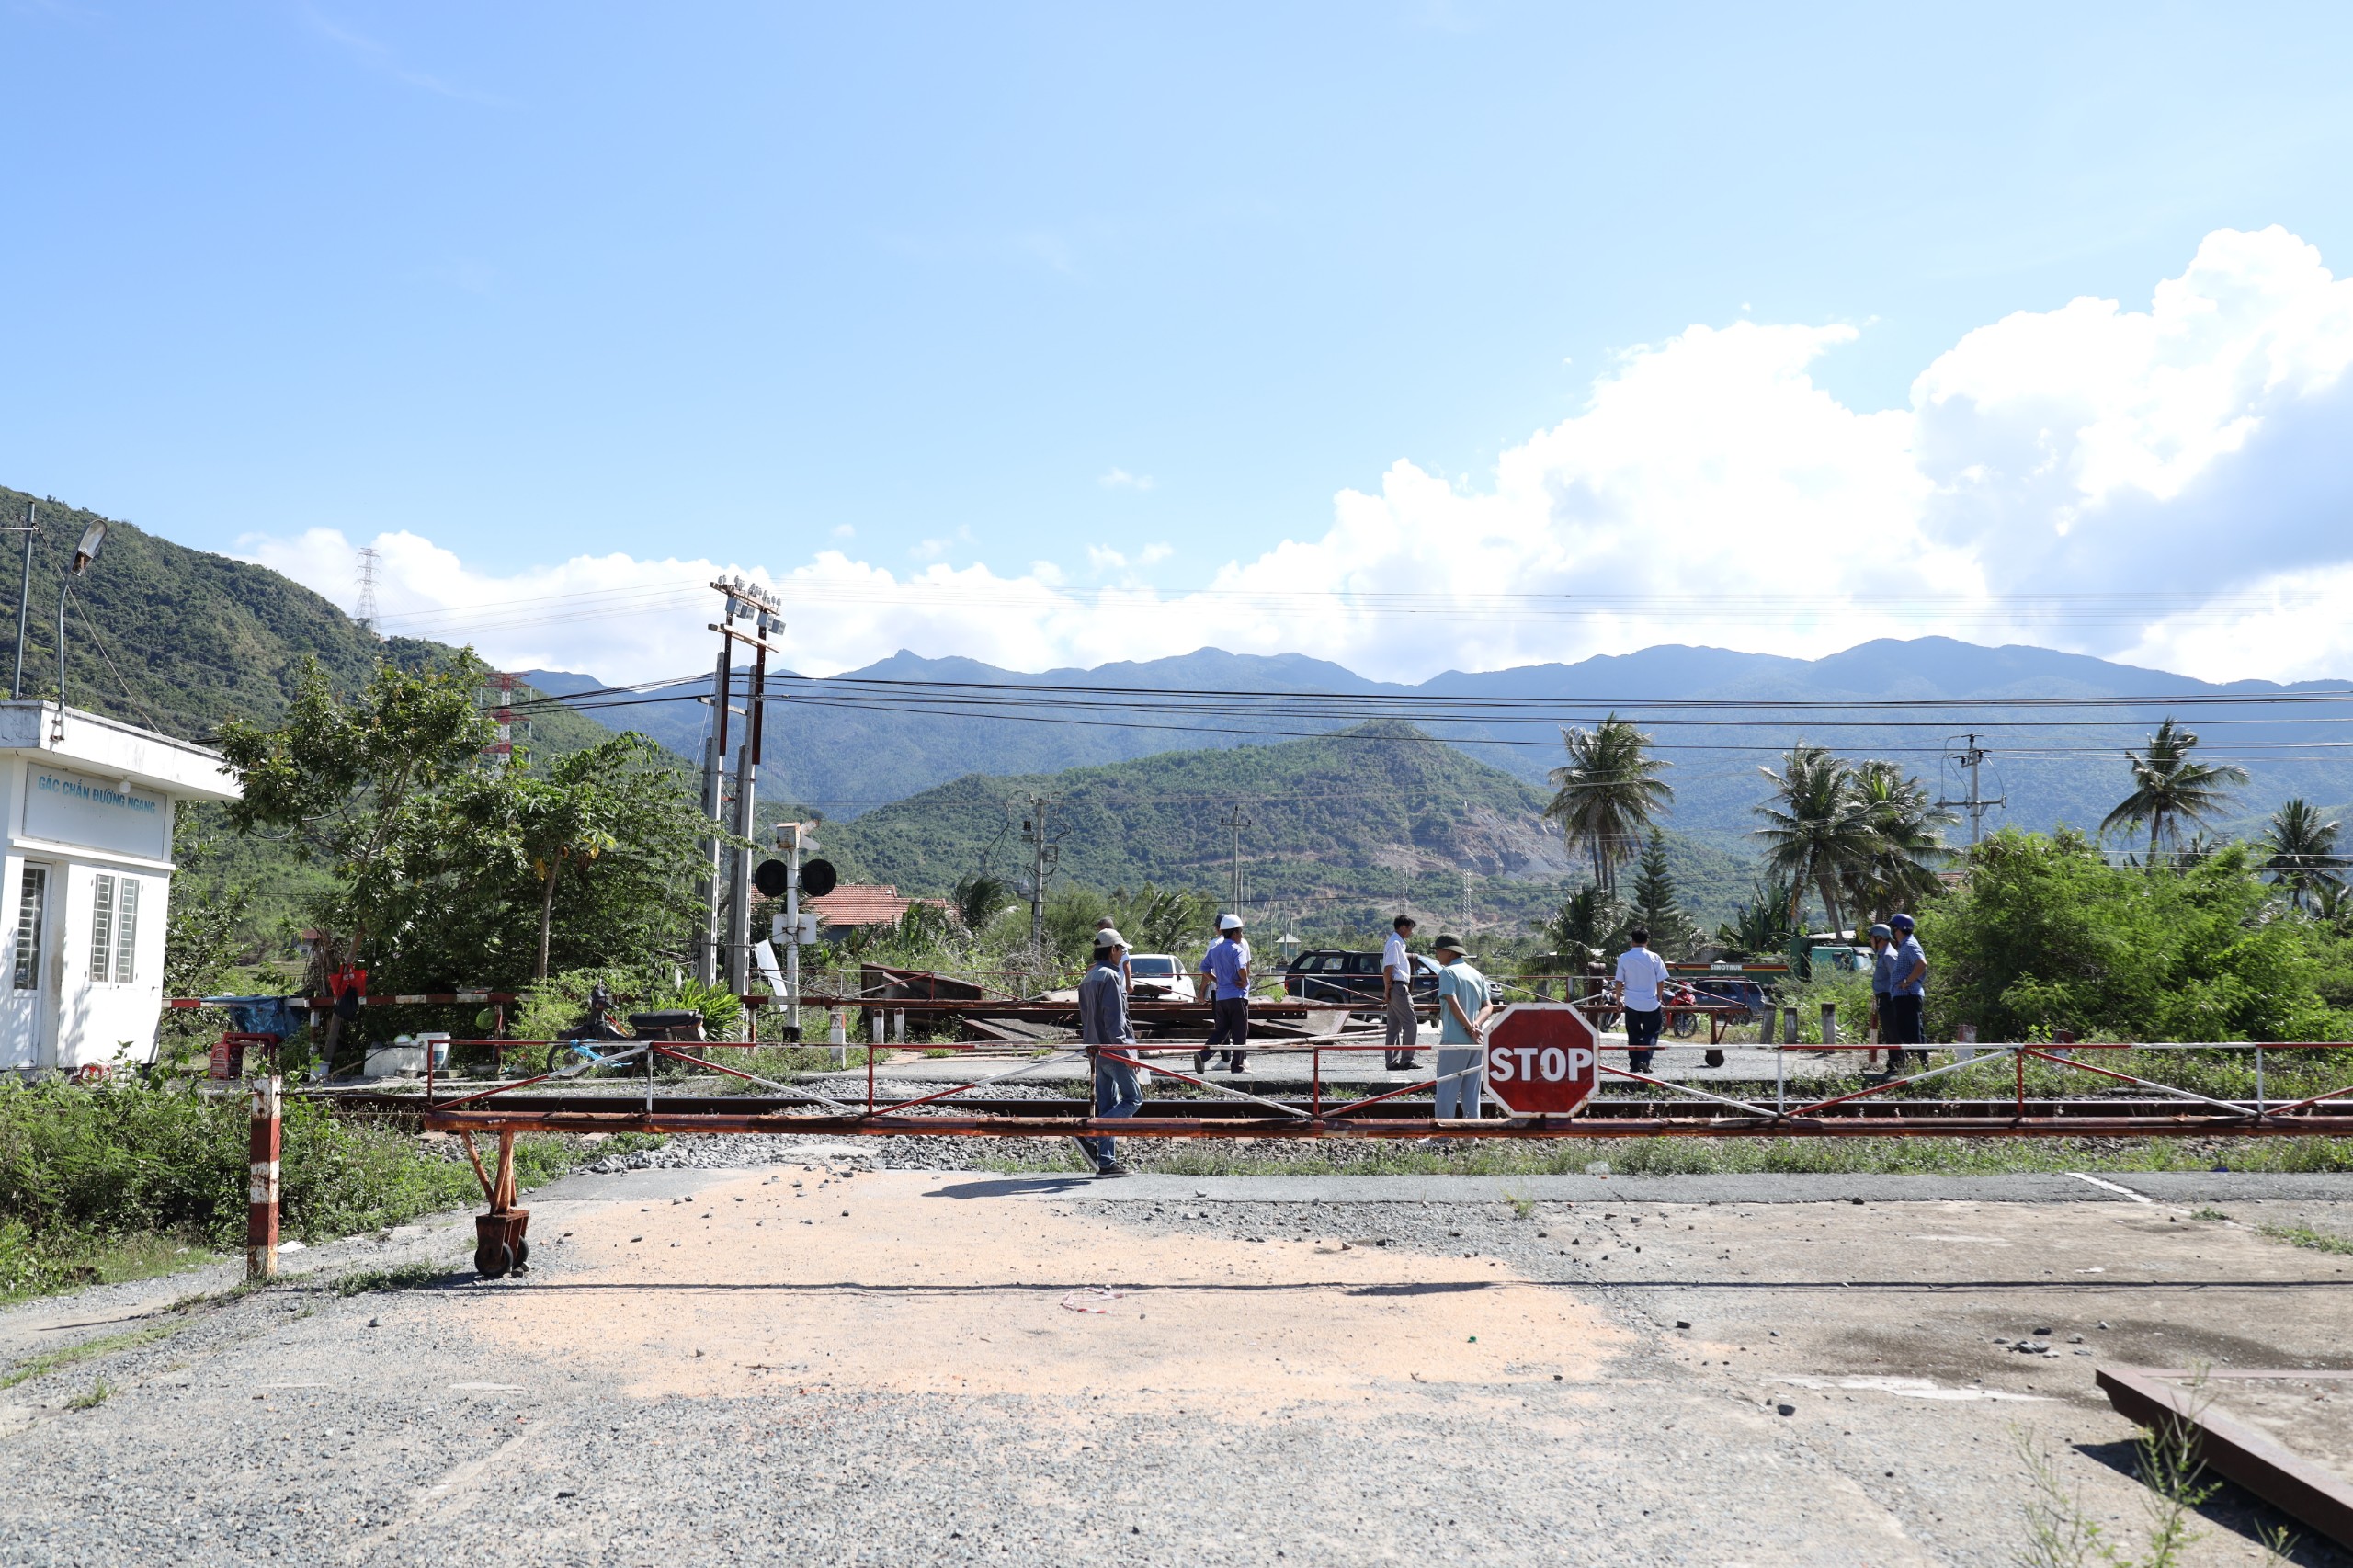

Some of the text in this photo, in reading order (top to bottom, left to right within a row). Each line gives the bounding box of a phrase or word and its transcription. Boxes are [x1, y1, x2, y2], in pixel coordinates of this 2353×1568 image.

[39, 774, 156, 814] GÁC CHẮN ĐƯỜNG NGANG
[1489, 1047, 1593, 1082] STOP
